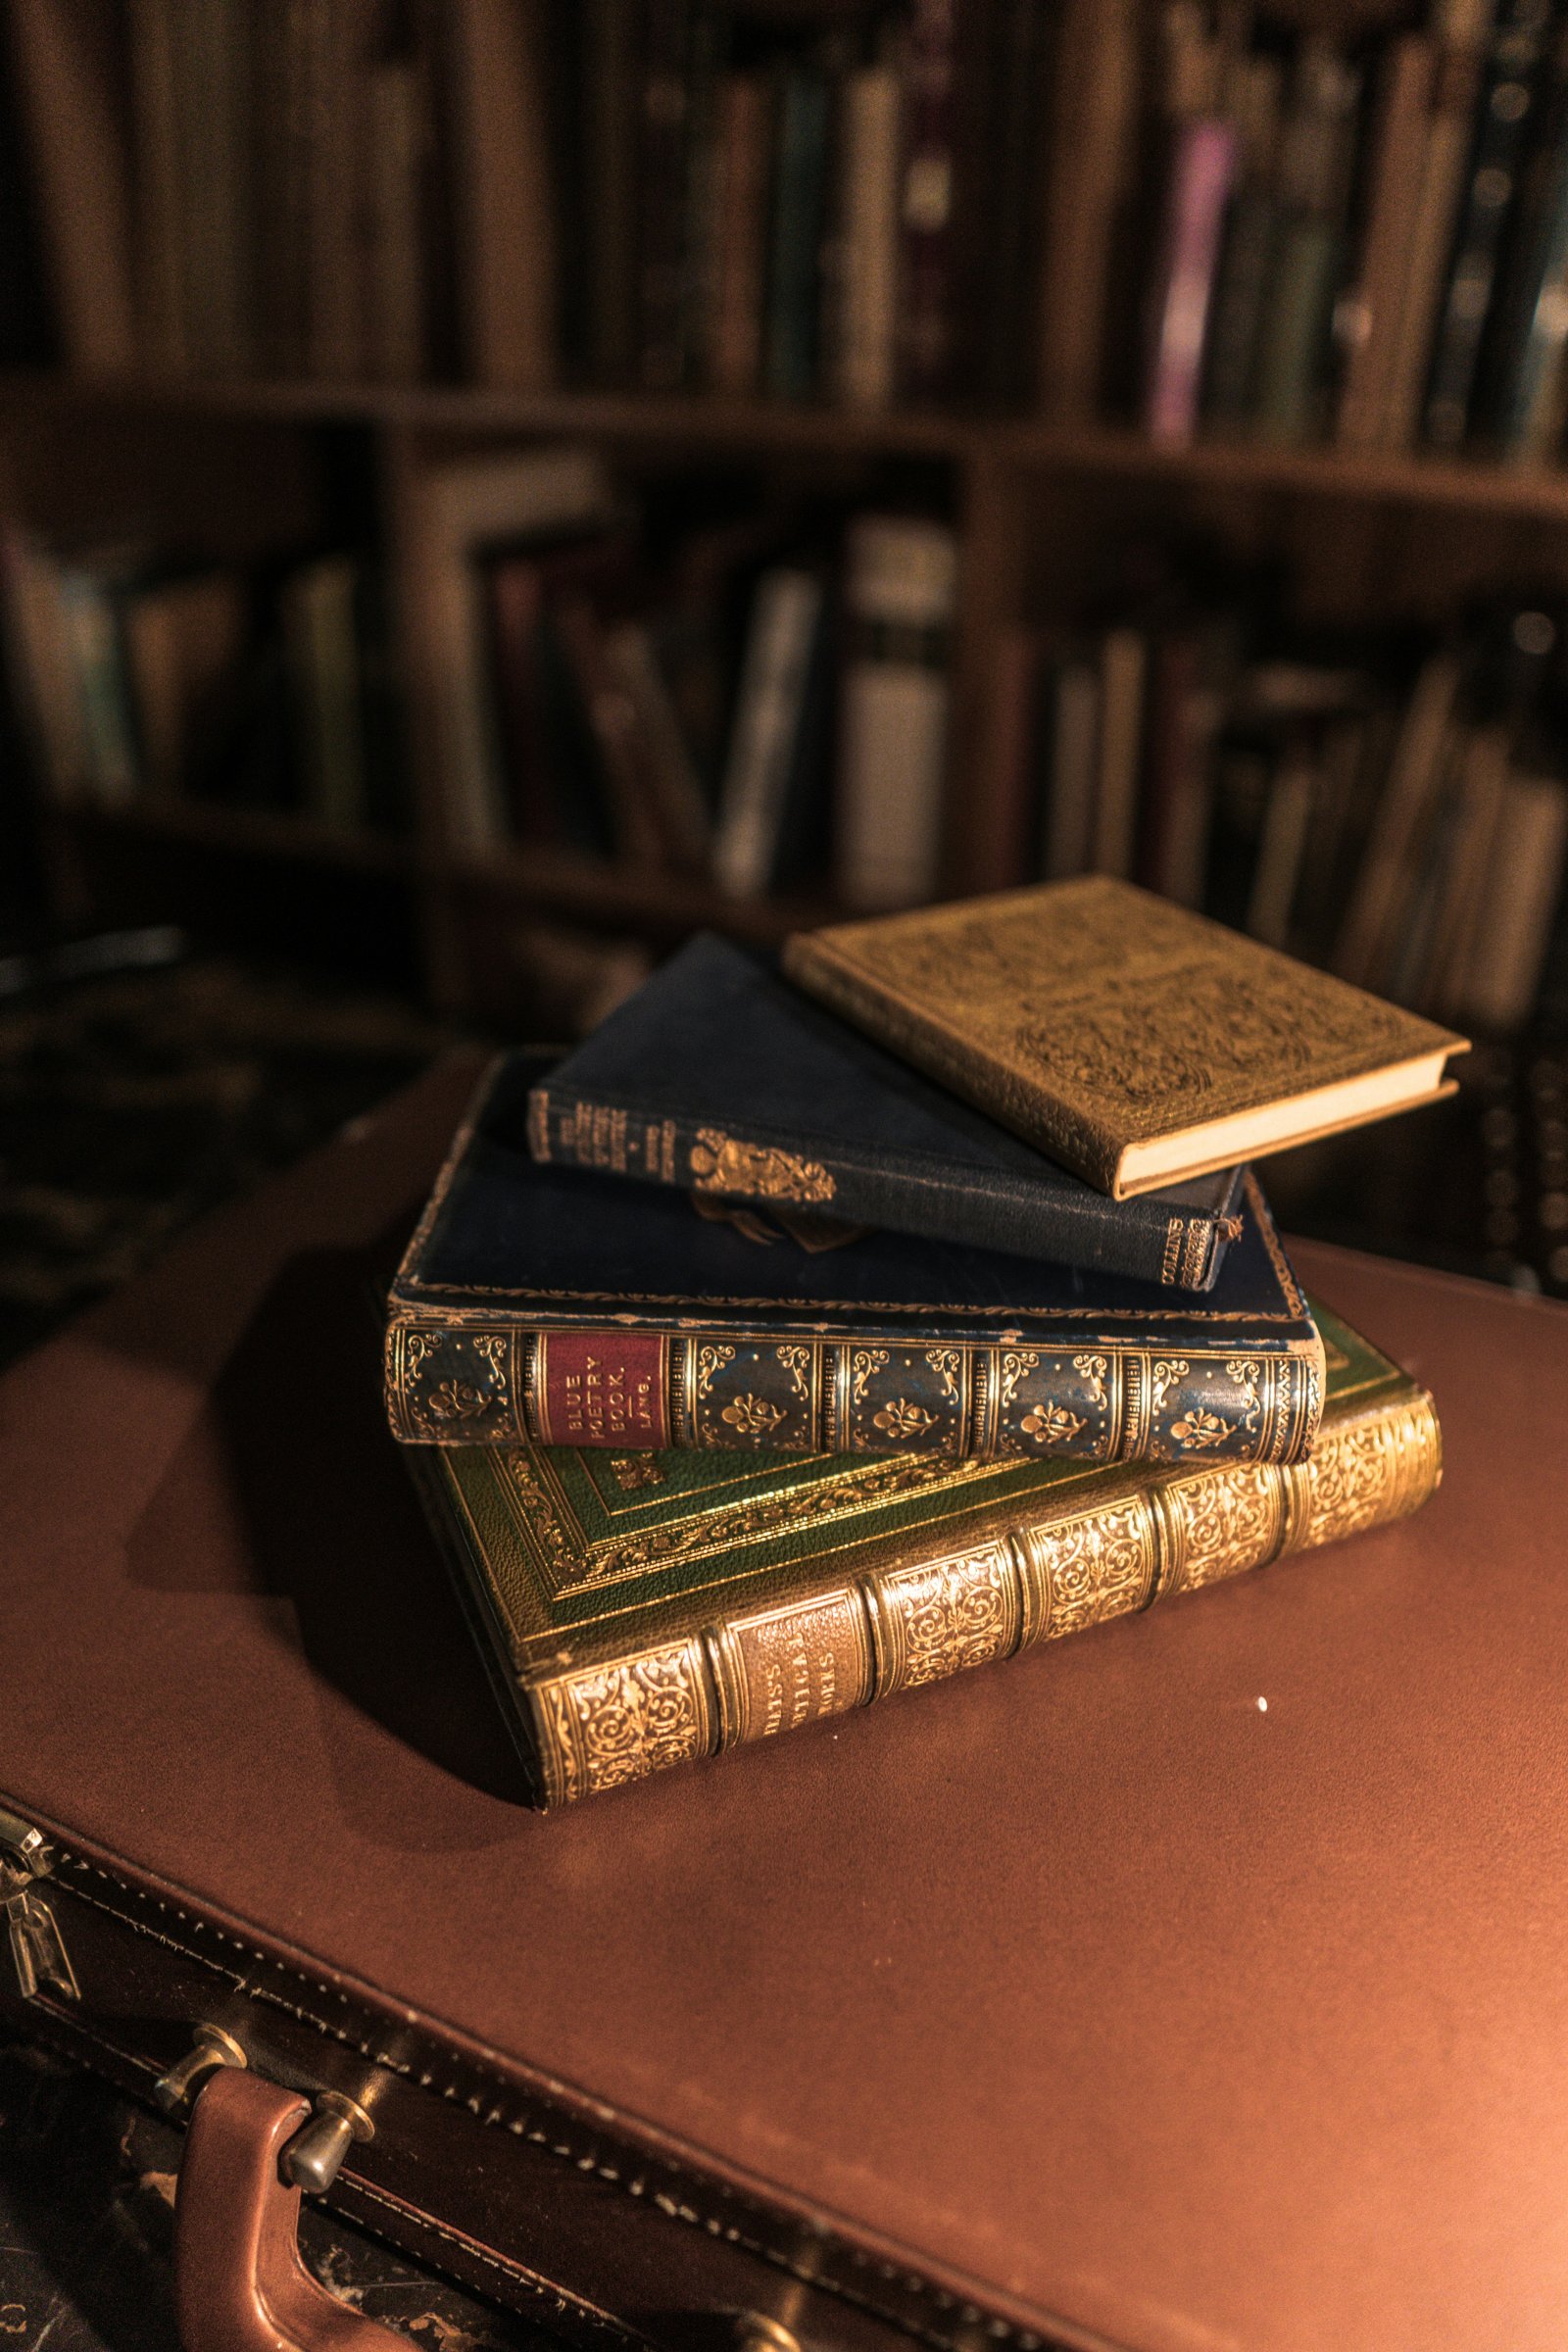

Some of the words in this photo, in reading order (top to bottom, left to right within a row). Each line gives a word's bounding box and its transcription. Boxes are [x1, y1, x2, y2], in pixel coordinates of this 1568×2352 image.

[565, 1375, 583, 1430] BLUE
[587, 1355, 605, 1439] POETRY
[609, 1367, 626, 1432] BOOK.
[638, 1375, 652, 1429] LANG.
